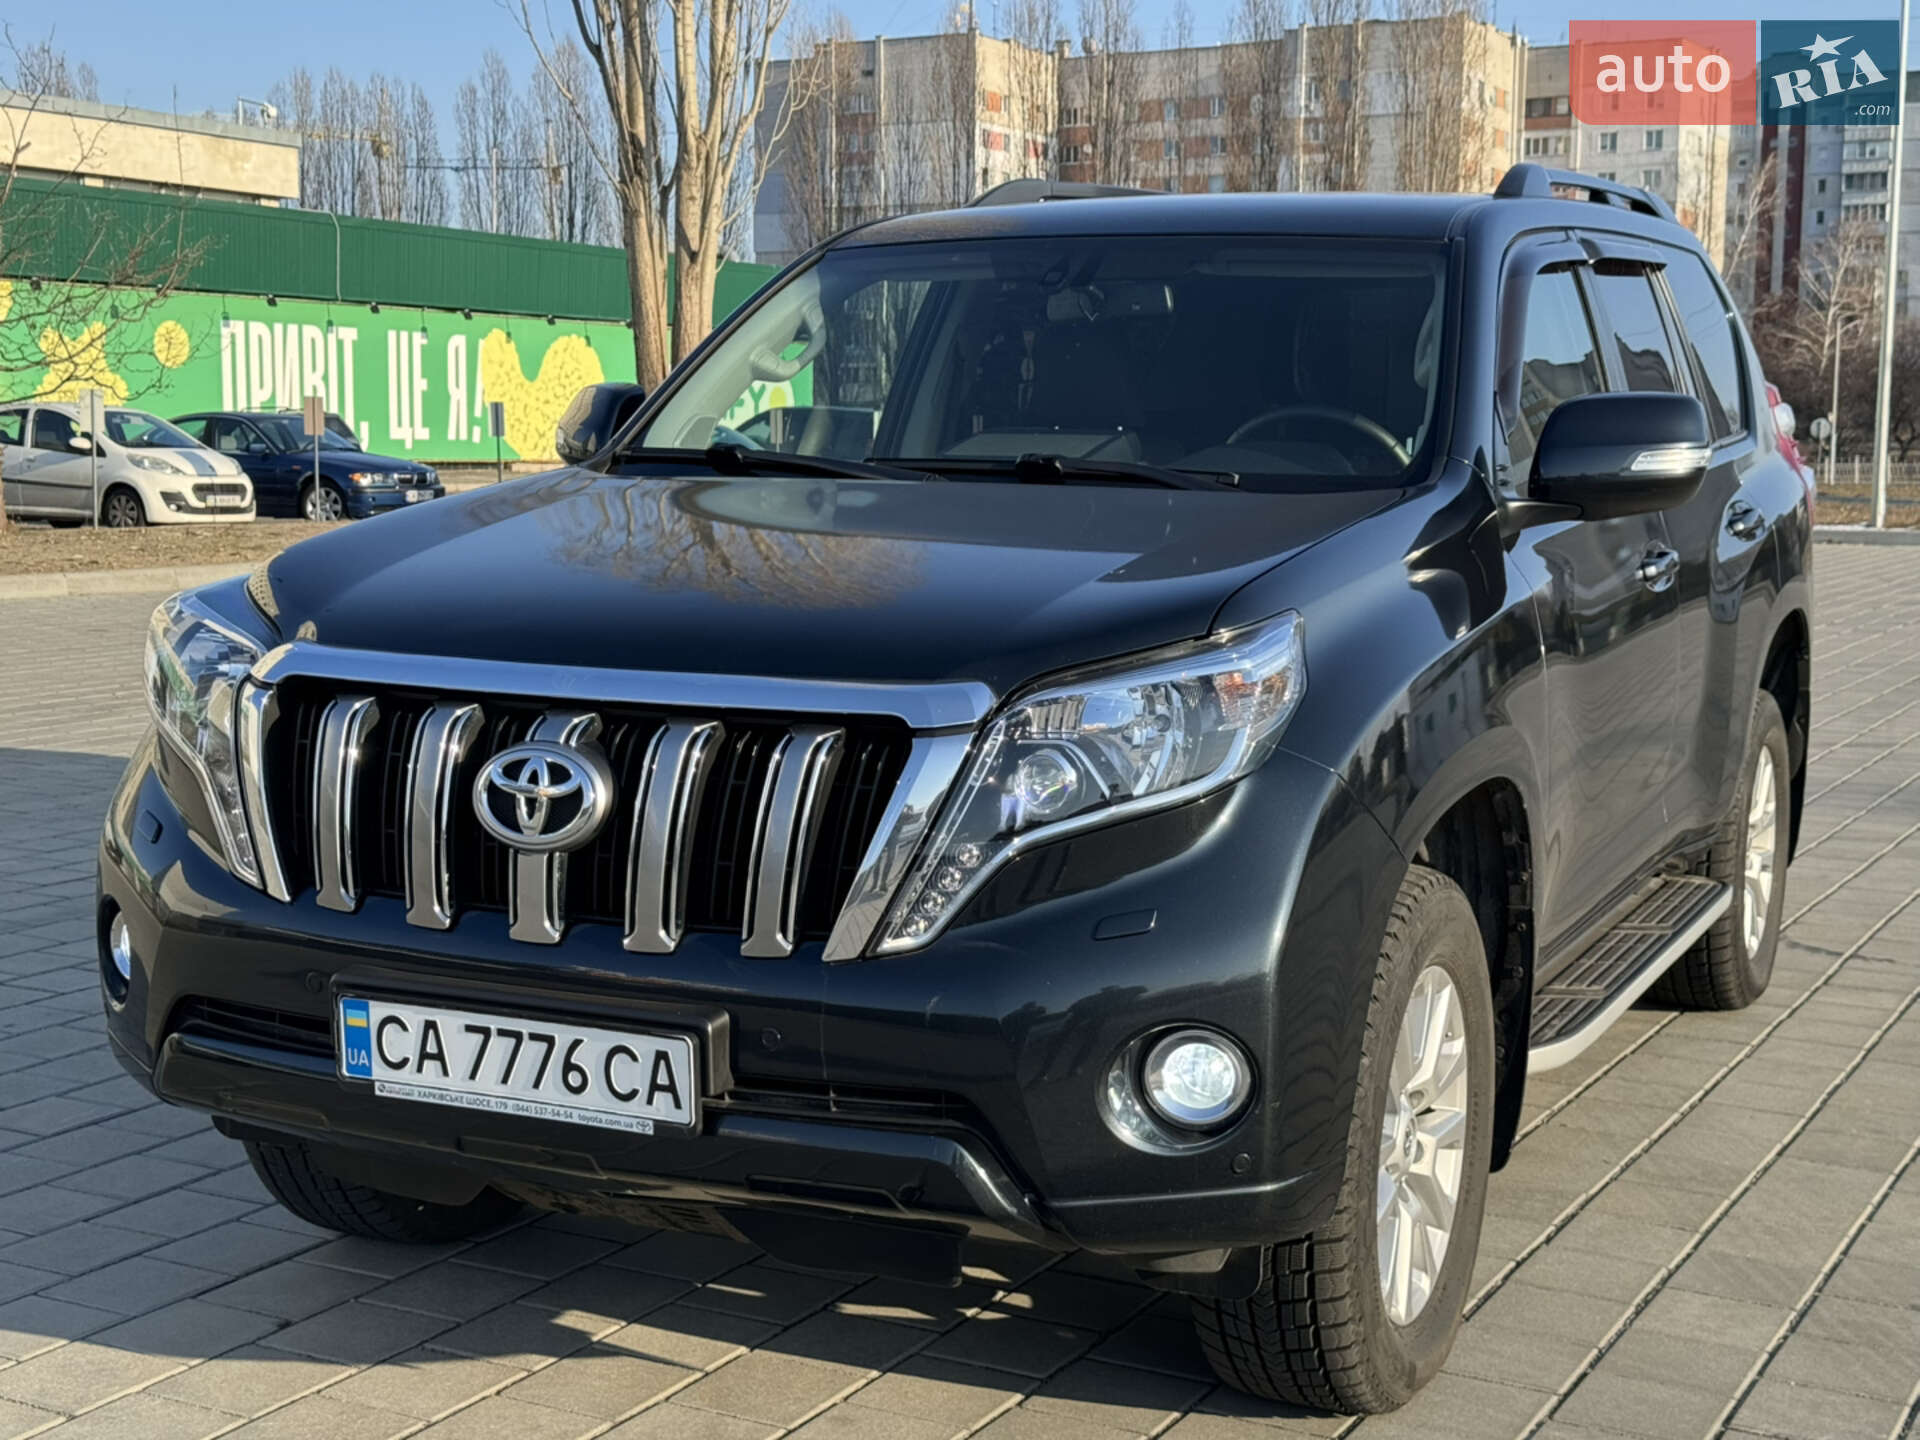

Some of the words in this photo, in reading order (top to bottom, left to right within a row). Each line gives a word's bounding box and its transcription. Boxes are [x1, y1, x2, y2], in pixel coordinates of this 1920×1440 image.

[387, 329, 430, 449] ЦЕ
[347, 1048, 370, 1067] UA
[464, 1025, 591, 1096] 7776
[577, 1113, 635, 1129] toyota.com.ua
